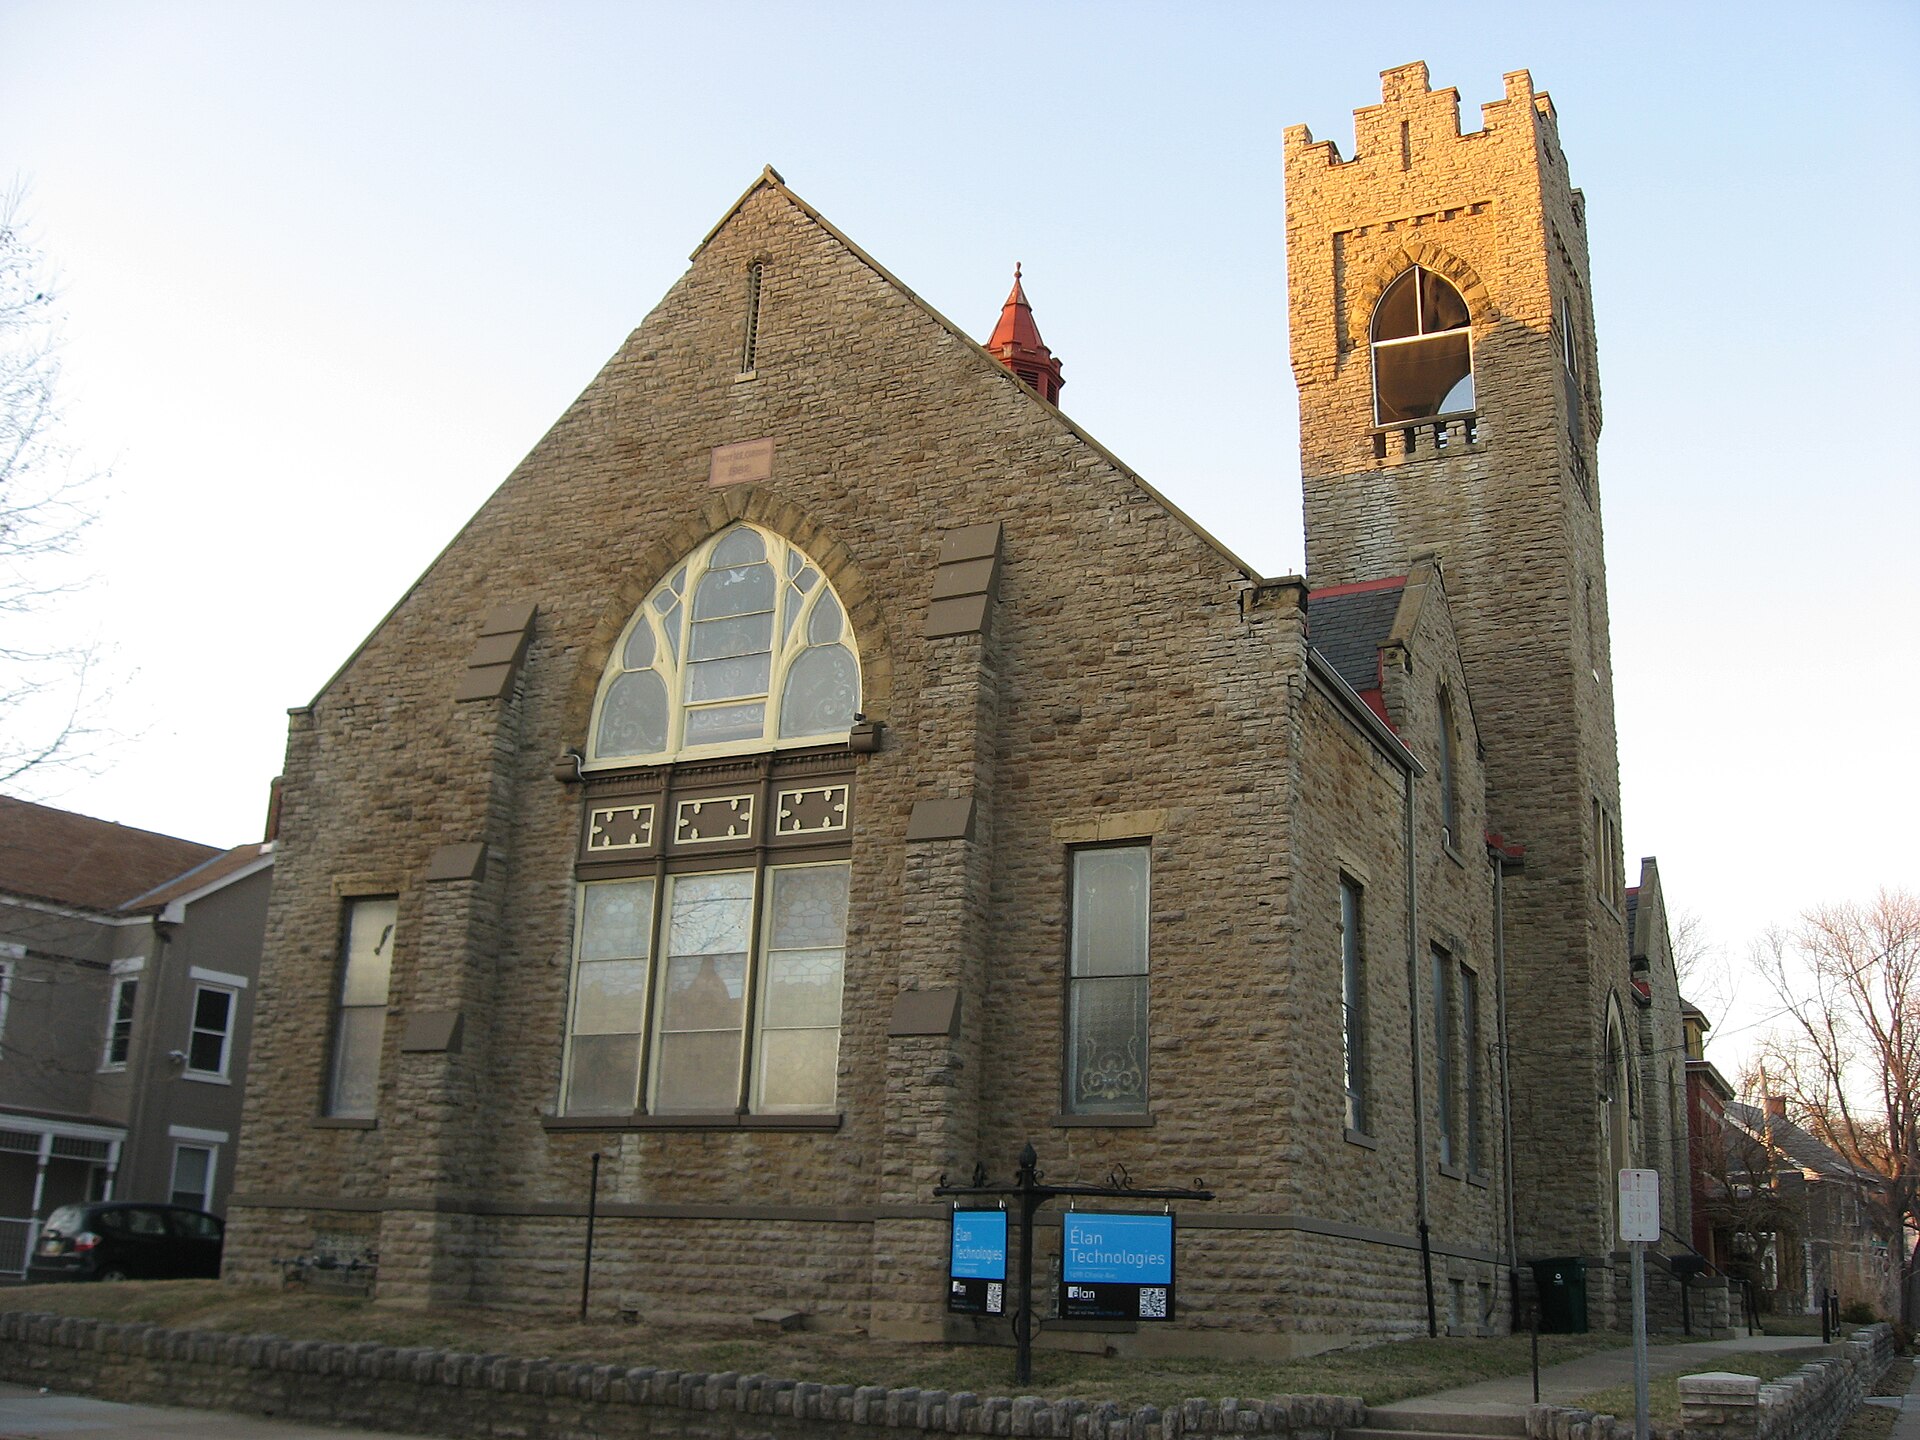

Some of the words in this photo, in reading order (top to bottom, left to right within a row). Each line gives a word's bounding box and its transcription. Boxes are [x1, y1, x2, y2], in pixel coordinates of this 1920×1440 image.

[1070, 1226, 1103, 1245] Élan
[955, 1244, 1003, 1265] Technologies
[1069, 1248, 1166, 1269] Technologies
